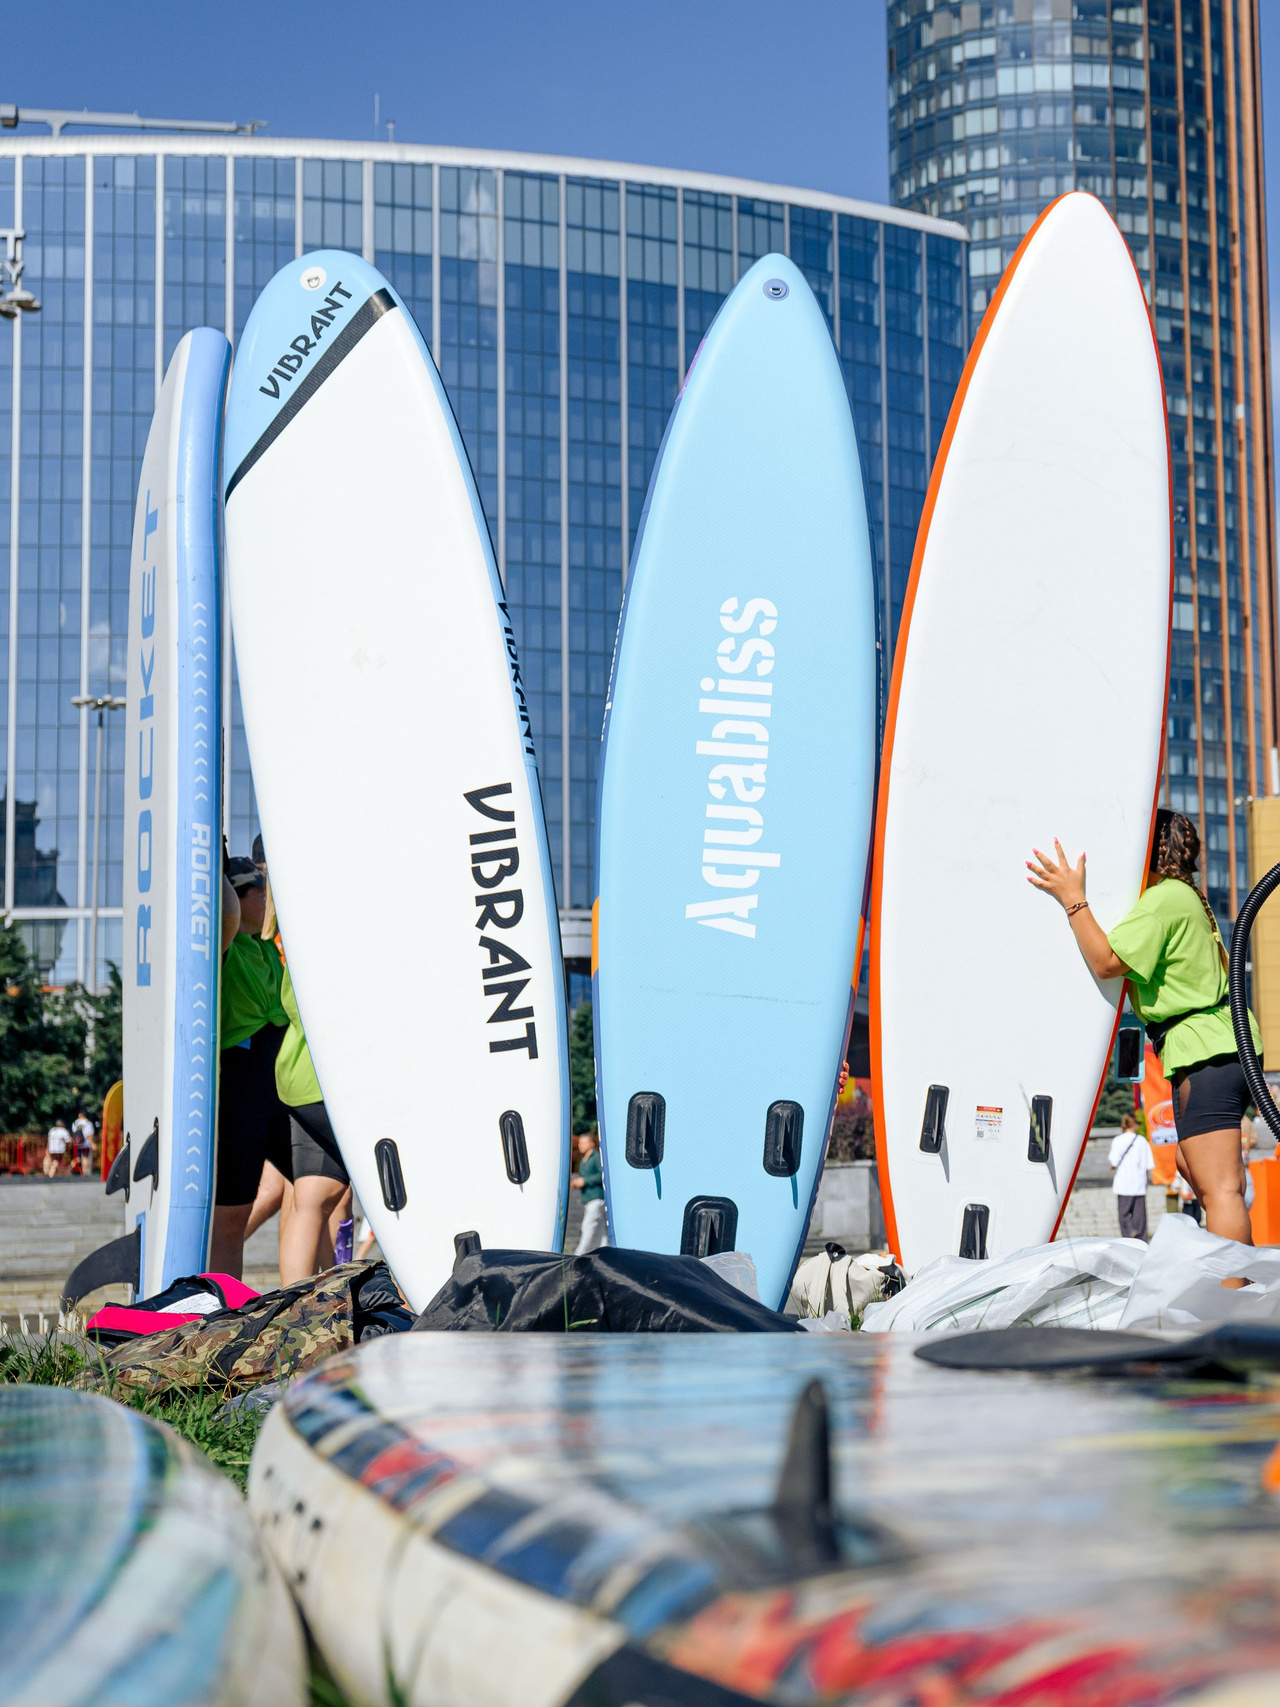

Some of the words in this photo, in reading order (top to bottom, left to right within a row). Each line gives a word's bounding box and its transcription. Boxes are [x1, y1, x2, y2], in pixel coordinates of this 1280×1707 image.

[259, 281, 354, 399] VIBRANT
[135, 489, 159, 987] ROCKET
[686, 597, 781, 939] Aquabliss
[191, 822, 211, 961] ROCKET
[463, 782, 539, 1060] VIBRANT
